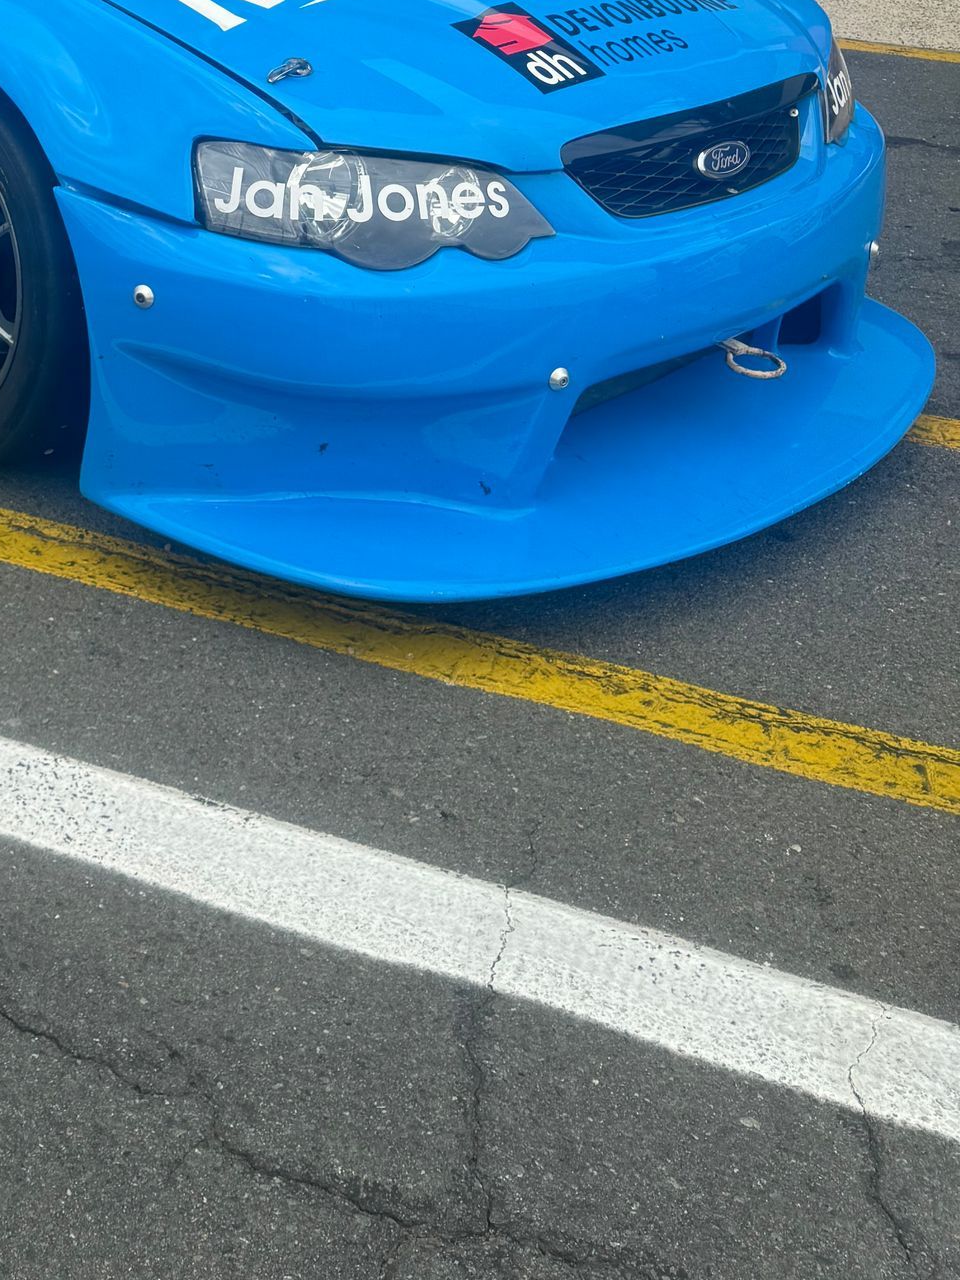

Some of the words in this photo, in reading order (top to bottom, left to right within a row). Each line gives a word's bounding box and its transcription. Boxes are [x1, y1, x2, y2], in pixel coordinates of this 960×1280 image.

[579, 27, 688, 66] homes
[526, 50, 587, 85] dh
[827, 71, 852, 115] Jan
[711, 145, 741, 170] Ford
[214, 167, 325, 221] Jan
[347, 175, 510, 223] Jones
